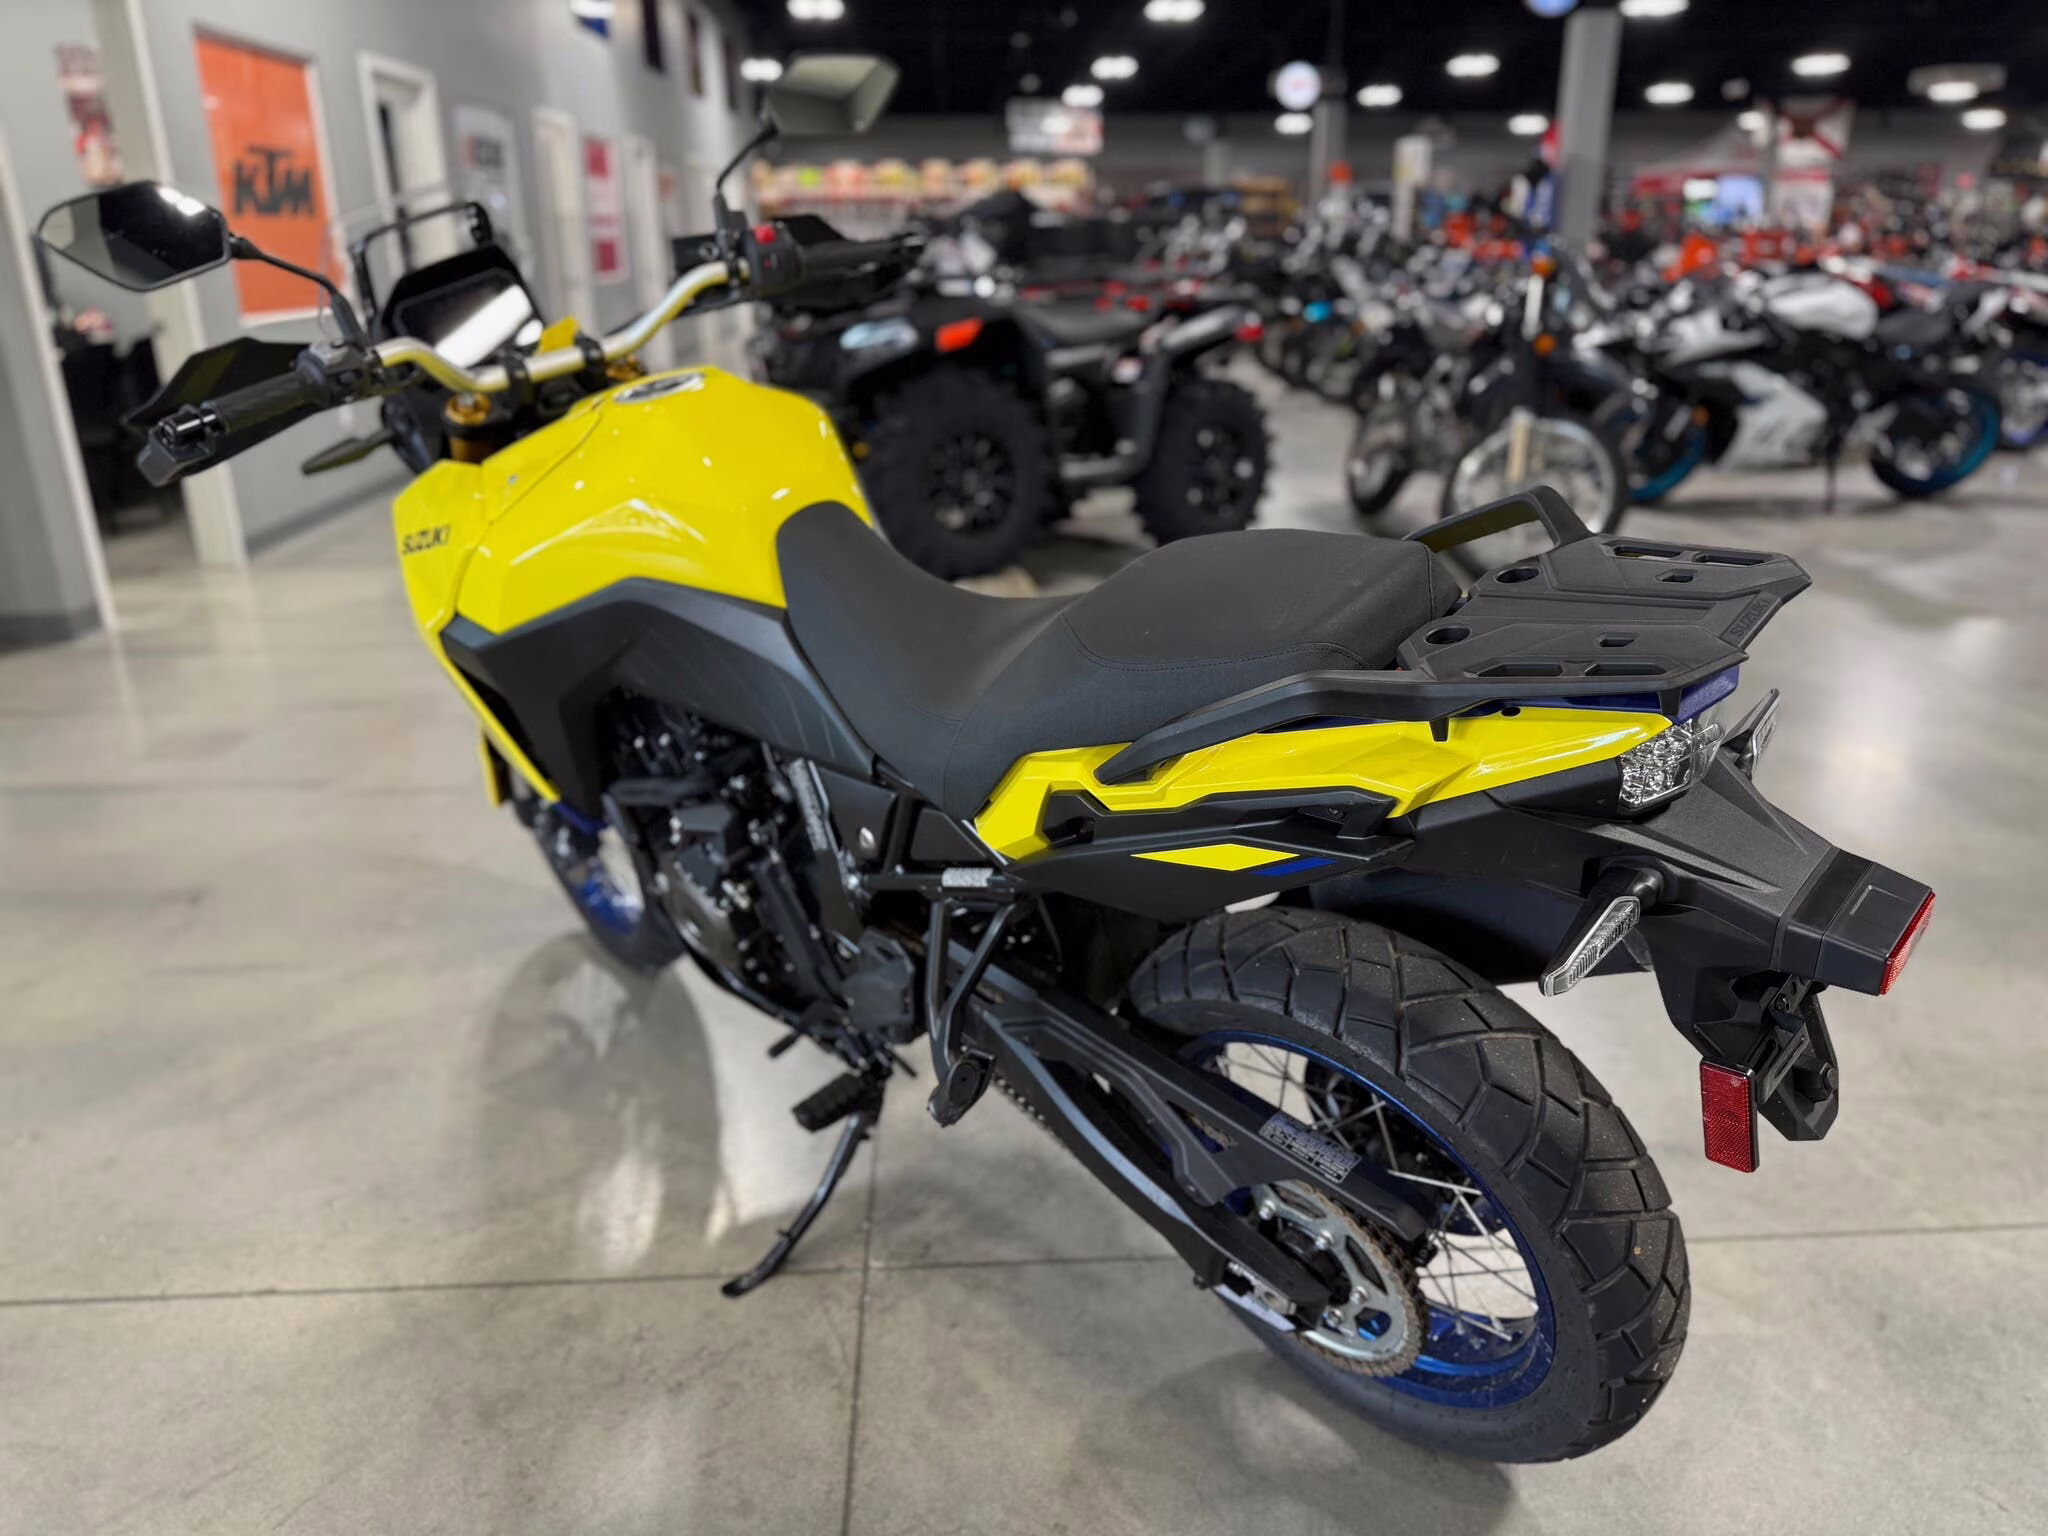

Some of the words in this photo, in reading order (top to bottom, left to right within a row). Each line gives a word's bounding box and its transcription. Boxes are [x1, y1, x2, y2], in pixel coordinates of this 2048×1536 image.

[234, 144, 315, 218] KTM
[402, 524, 451, 554] SUZUKI
[1730, 599, 1770, 637] SUZUKI
